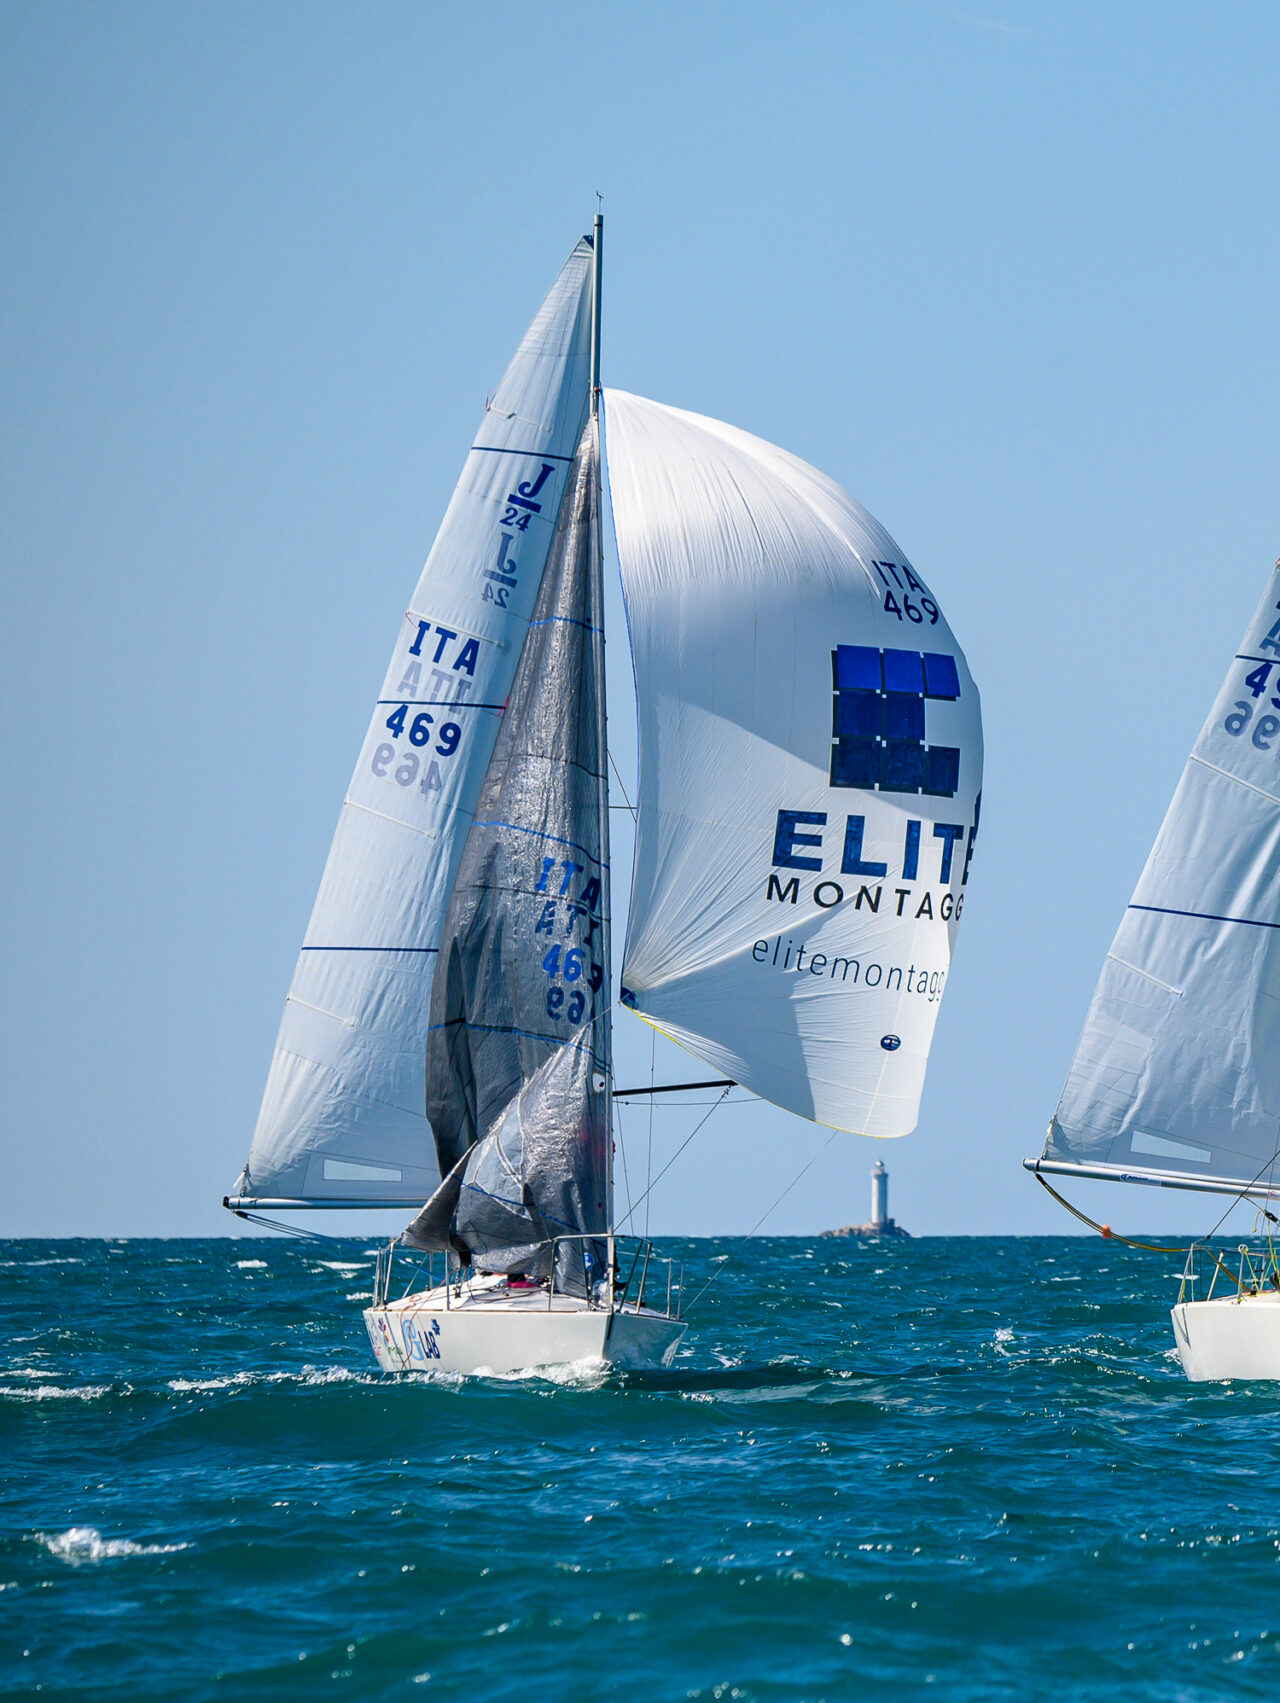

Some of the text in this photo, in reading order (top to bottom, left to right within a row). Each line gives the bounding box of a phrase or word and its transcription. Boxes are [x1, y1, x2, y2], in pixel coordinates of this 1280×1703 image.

[518, 463, 555, 498] J
[499, 507, 531, 532] 24
[871, 560, 926, 594] ITA
[883, 590, 939, 625] 469
[408, 620, 480, 676] ITA
[385, 703, 462, 757] 469
[535, 856, 601, 914] ITA
[542, 943, 603, 994] 469
